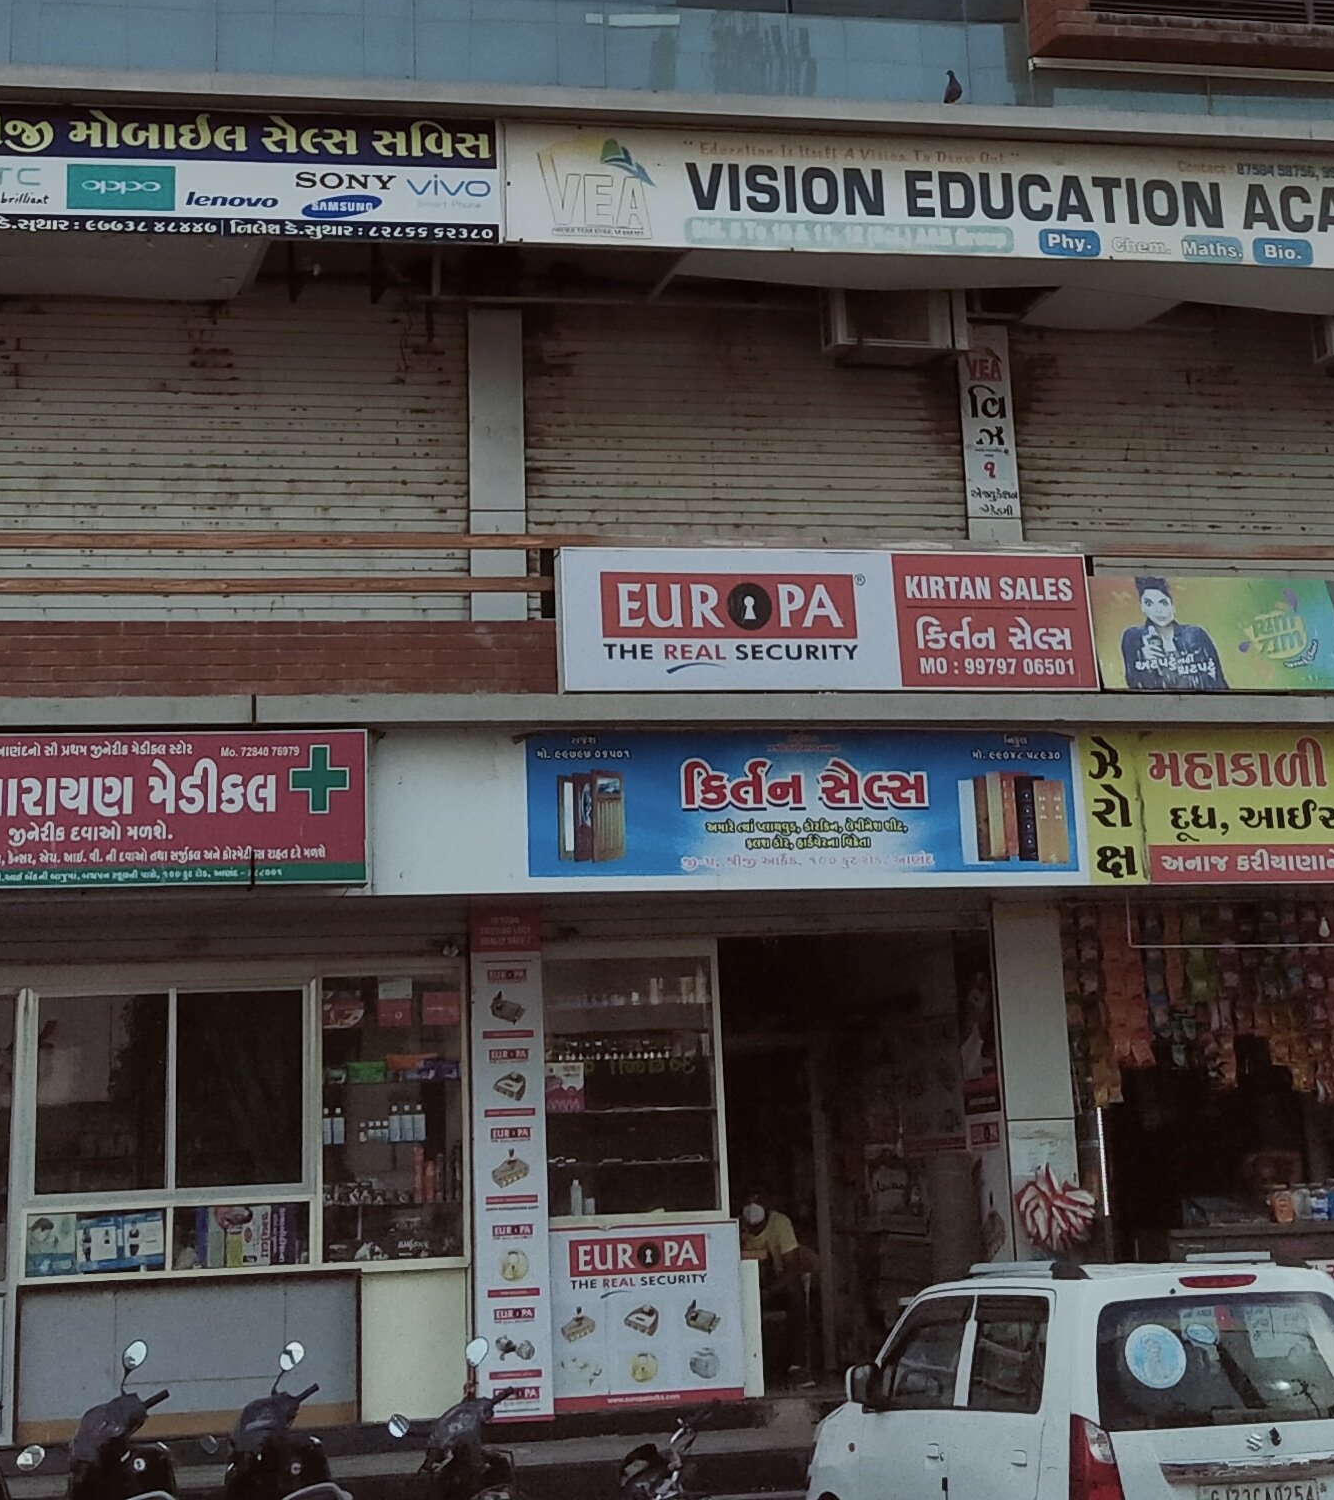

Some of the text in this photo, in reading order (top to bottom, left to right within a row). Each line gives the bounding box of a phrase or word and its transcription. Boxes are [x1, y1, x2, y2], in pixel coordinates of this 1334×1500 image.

[261, 115, 358, 155] સેલ્સ
[82, 180, 161, 194] oppo
[296, 172, 396, 190] SONY
[407, 175, 491, 197] vivo
[1, 192, 49, 205] brilliant
[185, 192, 279, 209] lenovo
[685, 161, 885, 217] VISION
[903, 169, 1224, 229] EDUCATION
[311, 201, 374, 212] SAMSUNG
[230, 220, 280, 235] નિલેશ
[1048, 234, 1093, 253] Phy.
[1183, 240, 1243, 259] Maths.
[1265, 243, 1302, 261] Bio.
[905, 575, 1073, 601] KIRTAN SALES
[617, 583, 844, 629] EUROPA
[915, 615, 1072, 651] કિર્તન સેલ્સ
[603, 643, 858, 661] THE REAL SECURITY
[920, 658, 1075, 676] MO 99797 06501
[132, 741, 166, 755] મેડીકલ
[169, 740, 193, 755] સ્ટોર
[221, 747, 300, 757] Mo. 72840 76979
[1148, 737, 1328, 789] મહાકાળી
[148, 758, 276, 815] મેડીકલ
[681, 758, 929, 810] કિર્તન સેલ્સ
[1170, 803, 1230, 843] દૂધ,
[9, 821, 65, 846] જીનેરીક
[70, 821, 121, 841] દવાઓ
[1161, 853, 1228, 873] અનાજ
[578, 1240, 699, 1271] EUROPA
[571, 1273, 707, 1289] THE REAL SECURITY
